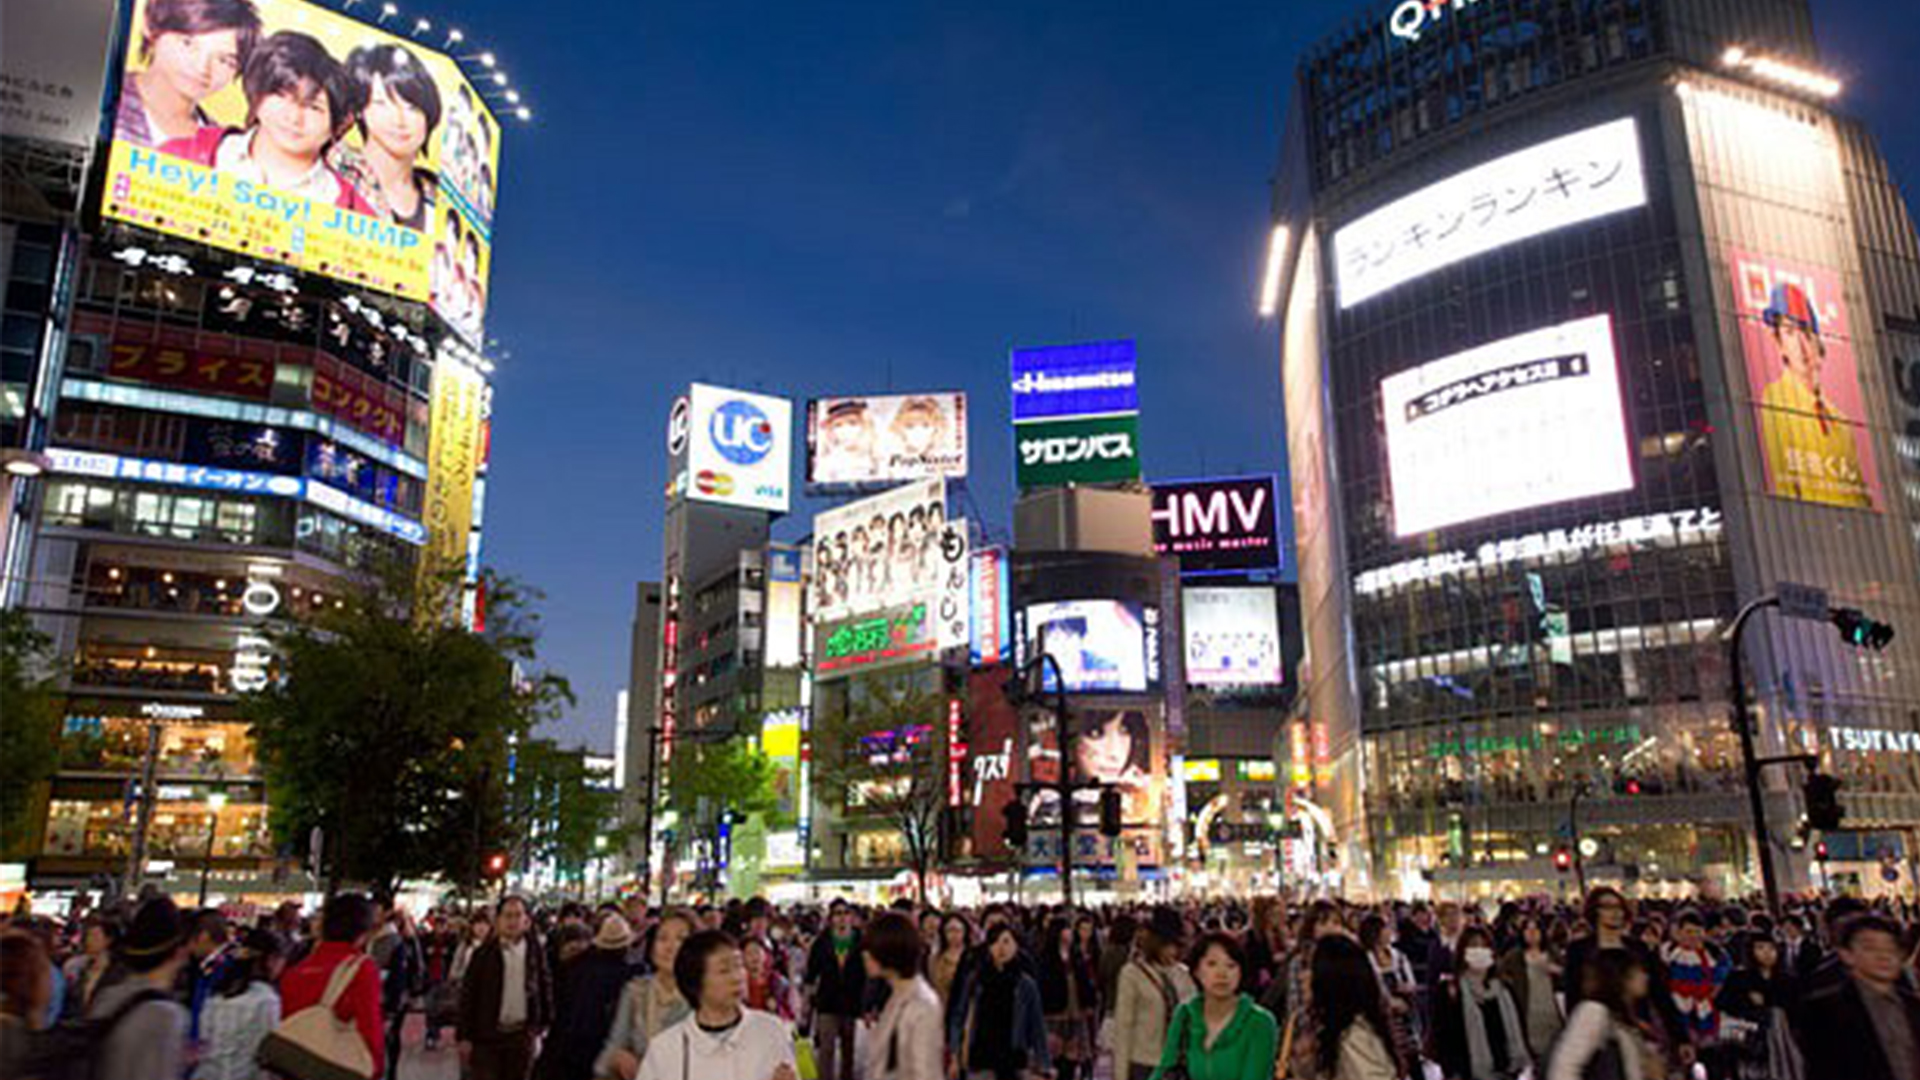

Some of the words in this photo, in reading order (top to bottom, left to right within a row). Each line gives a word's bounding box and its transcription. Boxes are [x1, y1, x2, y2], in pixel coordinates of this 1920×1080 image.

[129, 148, 217, 193] Hey!
[233, 179, 311, 220] Say!
[323, 209, 420, 247] JUMP
[1346, 159, 1623, 276] ランキンランキン
[112, 345, 267, 386] プライス
[314, 375, 402, 432] コンタクト
[714, 411, 772, 451] UC
[1019, 433, 1133, 464] サロンパス
[1151, 488, 1265, 536] HMV
[940, 526, 966, 638] もんじゃ
